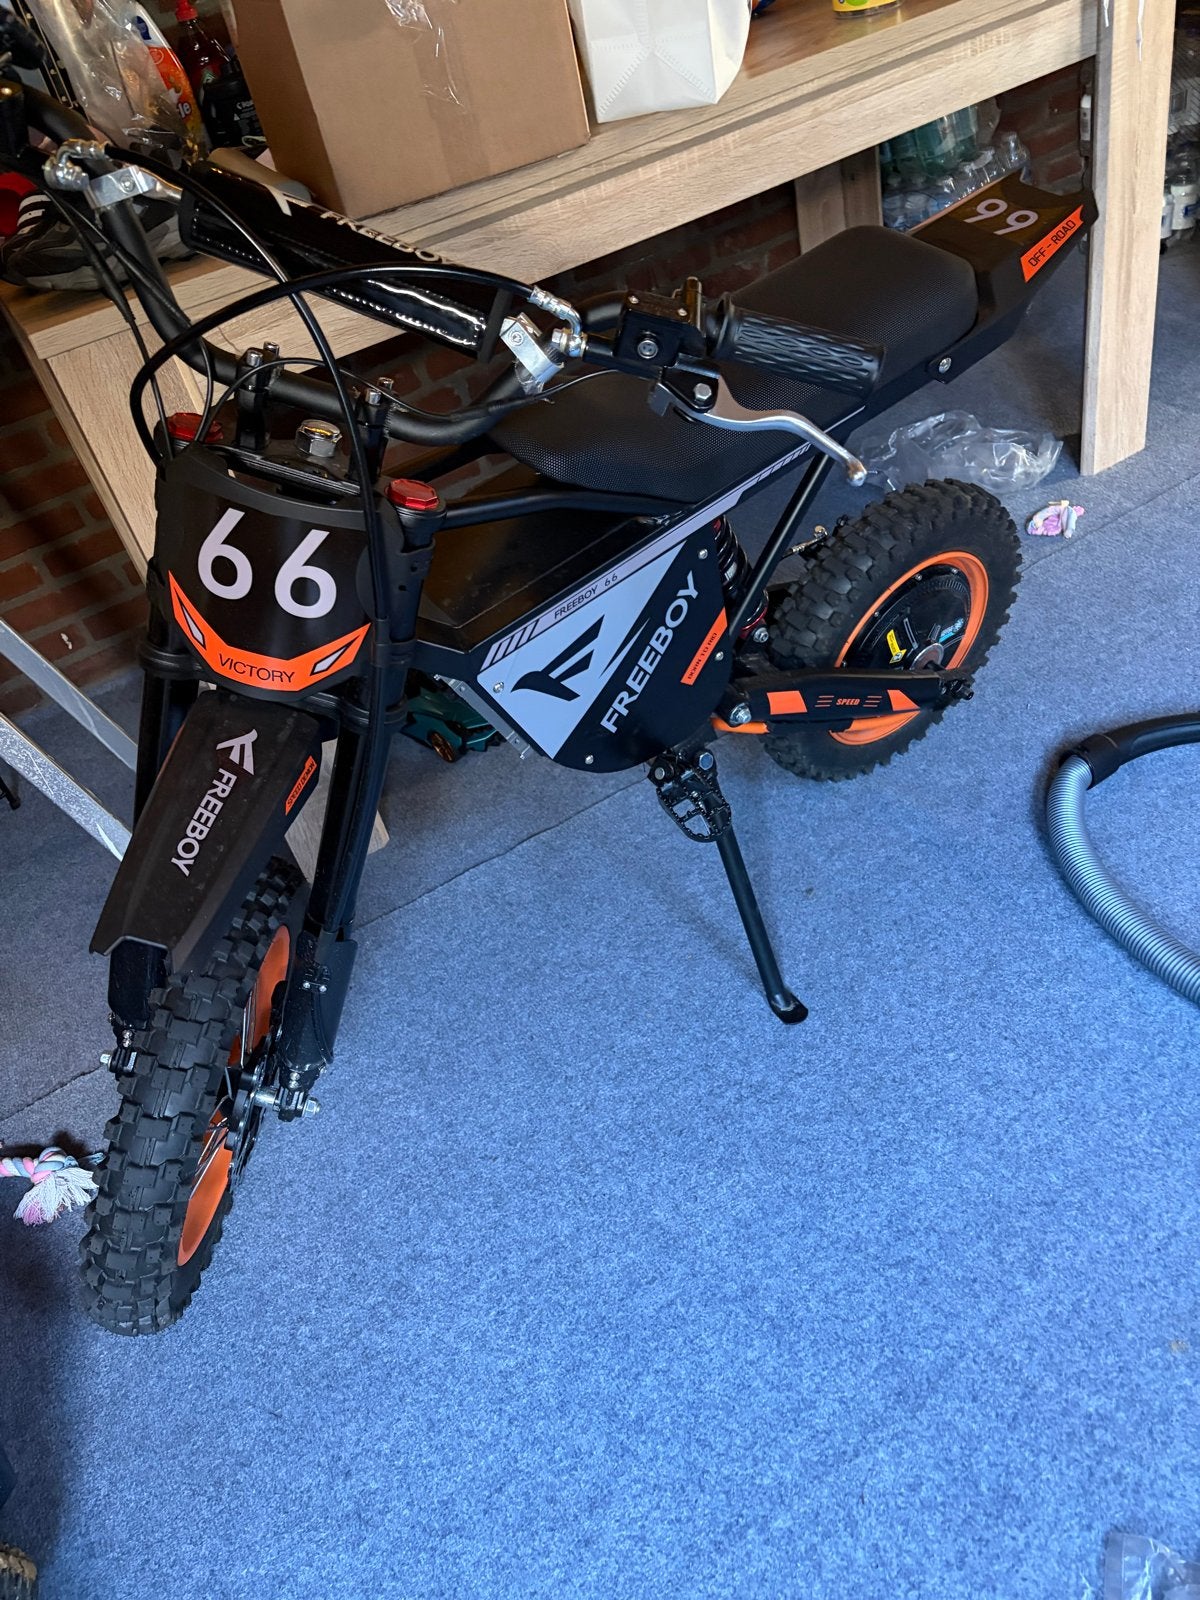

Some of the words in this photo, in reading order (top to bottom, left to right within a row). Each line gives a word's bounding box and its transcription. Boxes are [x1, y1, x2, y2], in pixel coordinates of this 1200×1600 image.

[554, 584, 598, 620] FREEBOY
[604, 573, 618, 587] 66
[218, 653, 296, 683] VICTORY
[599, 569, 699, 734] FREEBOY
[835, 698, 861, 706] SPEED
[170, 767, 238, 877] FREEBOY
